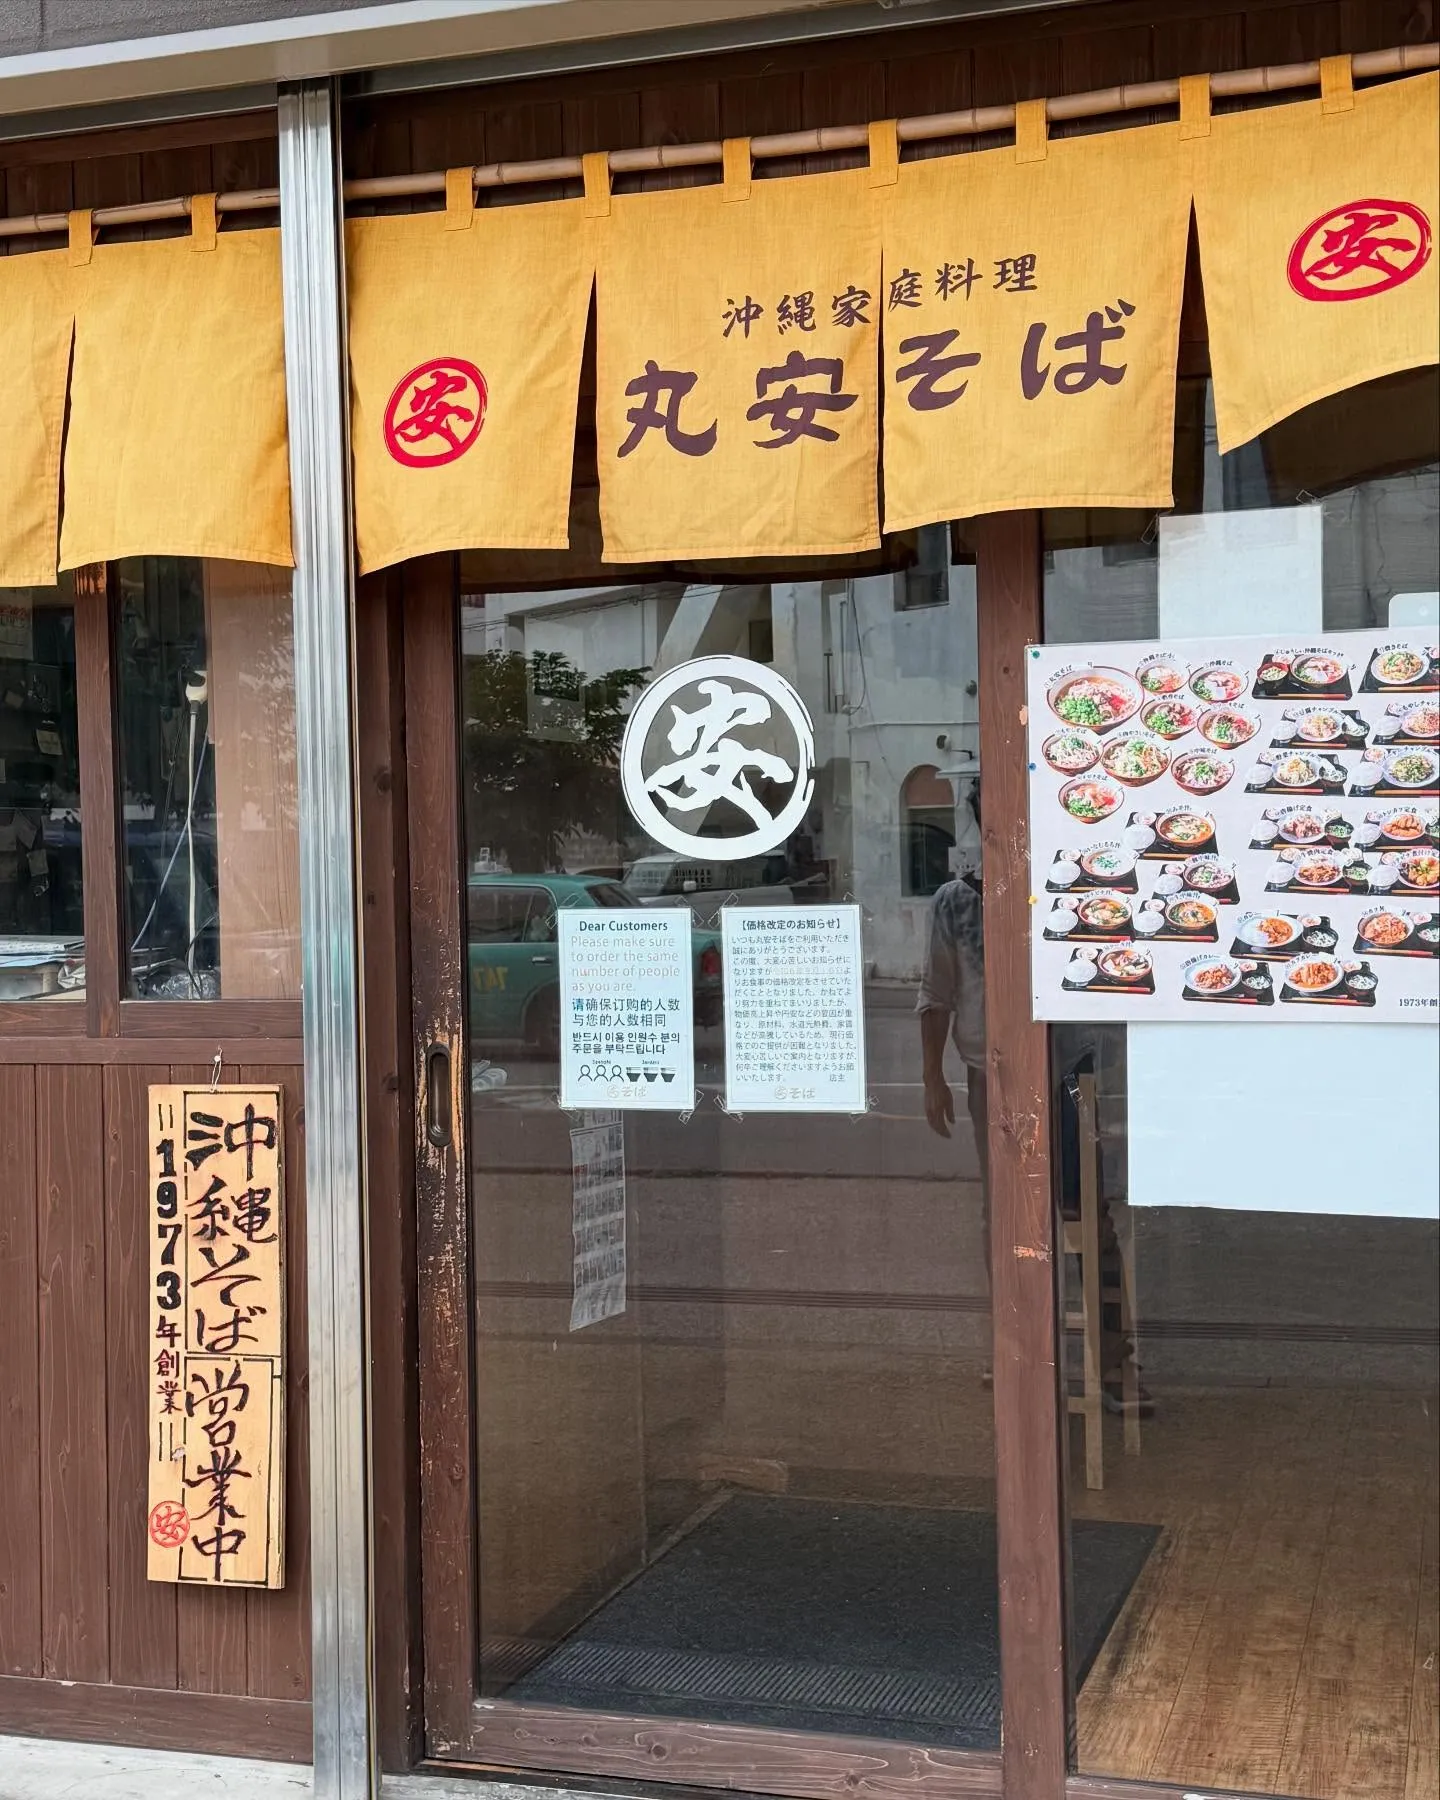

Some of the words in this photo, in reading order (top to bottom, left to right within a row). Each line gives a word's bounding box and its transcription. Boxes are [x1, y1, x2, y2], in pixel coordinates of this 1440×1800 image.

[721, 252, 1038, 339] 沖縄家庭料理
[616, 298, 1137, 459] 丸安そば
[634, 667, 805, 849] 安
[579, 920, 605, 932] Dear
[608, 920, 668, 931] Customers
[742, 918, 841, 931] 【価格改定のお知らせ】
[571, 936, 609, 947] Please
[613, 936, 645, 947] make
[649, 937, 675, 947] sure
[571, 951, 584, 962] to
[587, 950, 619, 962] order
[623, 950, 644, 962] the
[647, 952, 679, 962] same
[572, 965, 619, 977] number
[622, 965, 634, 977] of
[638, 966, 681, 979] people
[572, 983, 585, 992] as
[588, 983, 610, 995] you
[613, 982, 637, 992] are.
[572, 997, 681, 1012] 请确保订购的人数
[572, 1013, 667, 1027] 与您的人数相同
[572, 1032, 602, 1043] 반드시
[605, 1032, 625, 1043] 이용
[627, 1032, 658, 1043] 인원수
[660, 1032, 680, 1044] 분의
[572, 1043, 602, 1054] 주문을
[605, 1043, 666, 1055] 부탁드립니다
[184, 1102, 279, 1353] 沖縄そば
[154, 1138, 183, 1415] 1973年創業
[183, 1359, 252, 1582] 営業中
